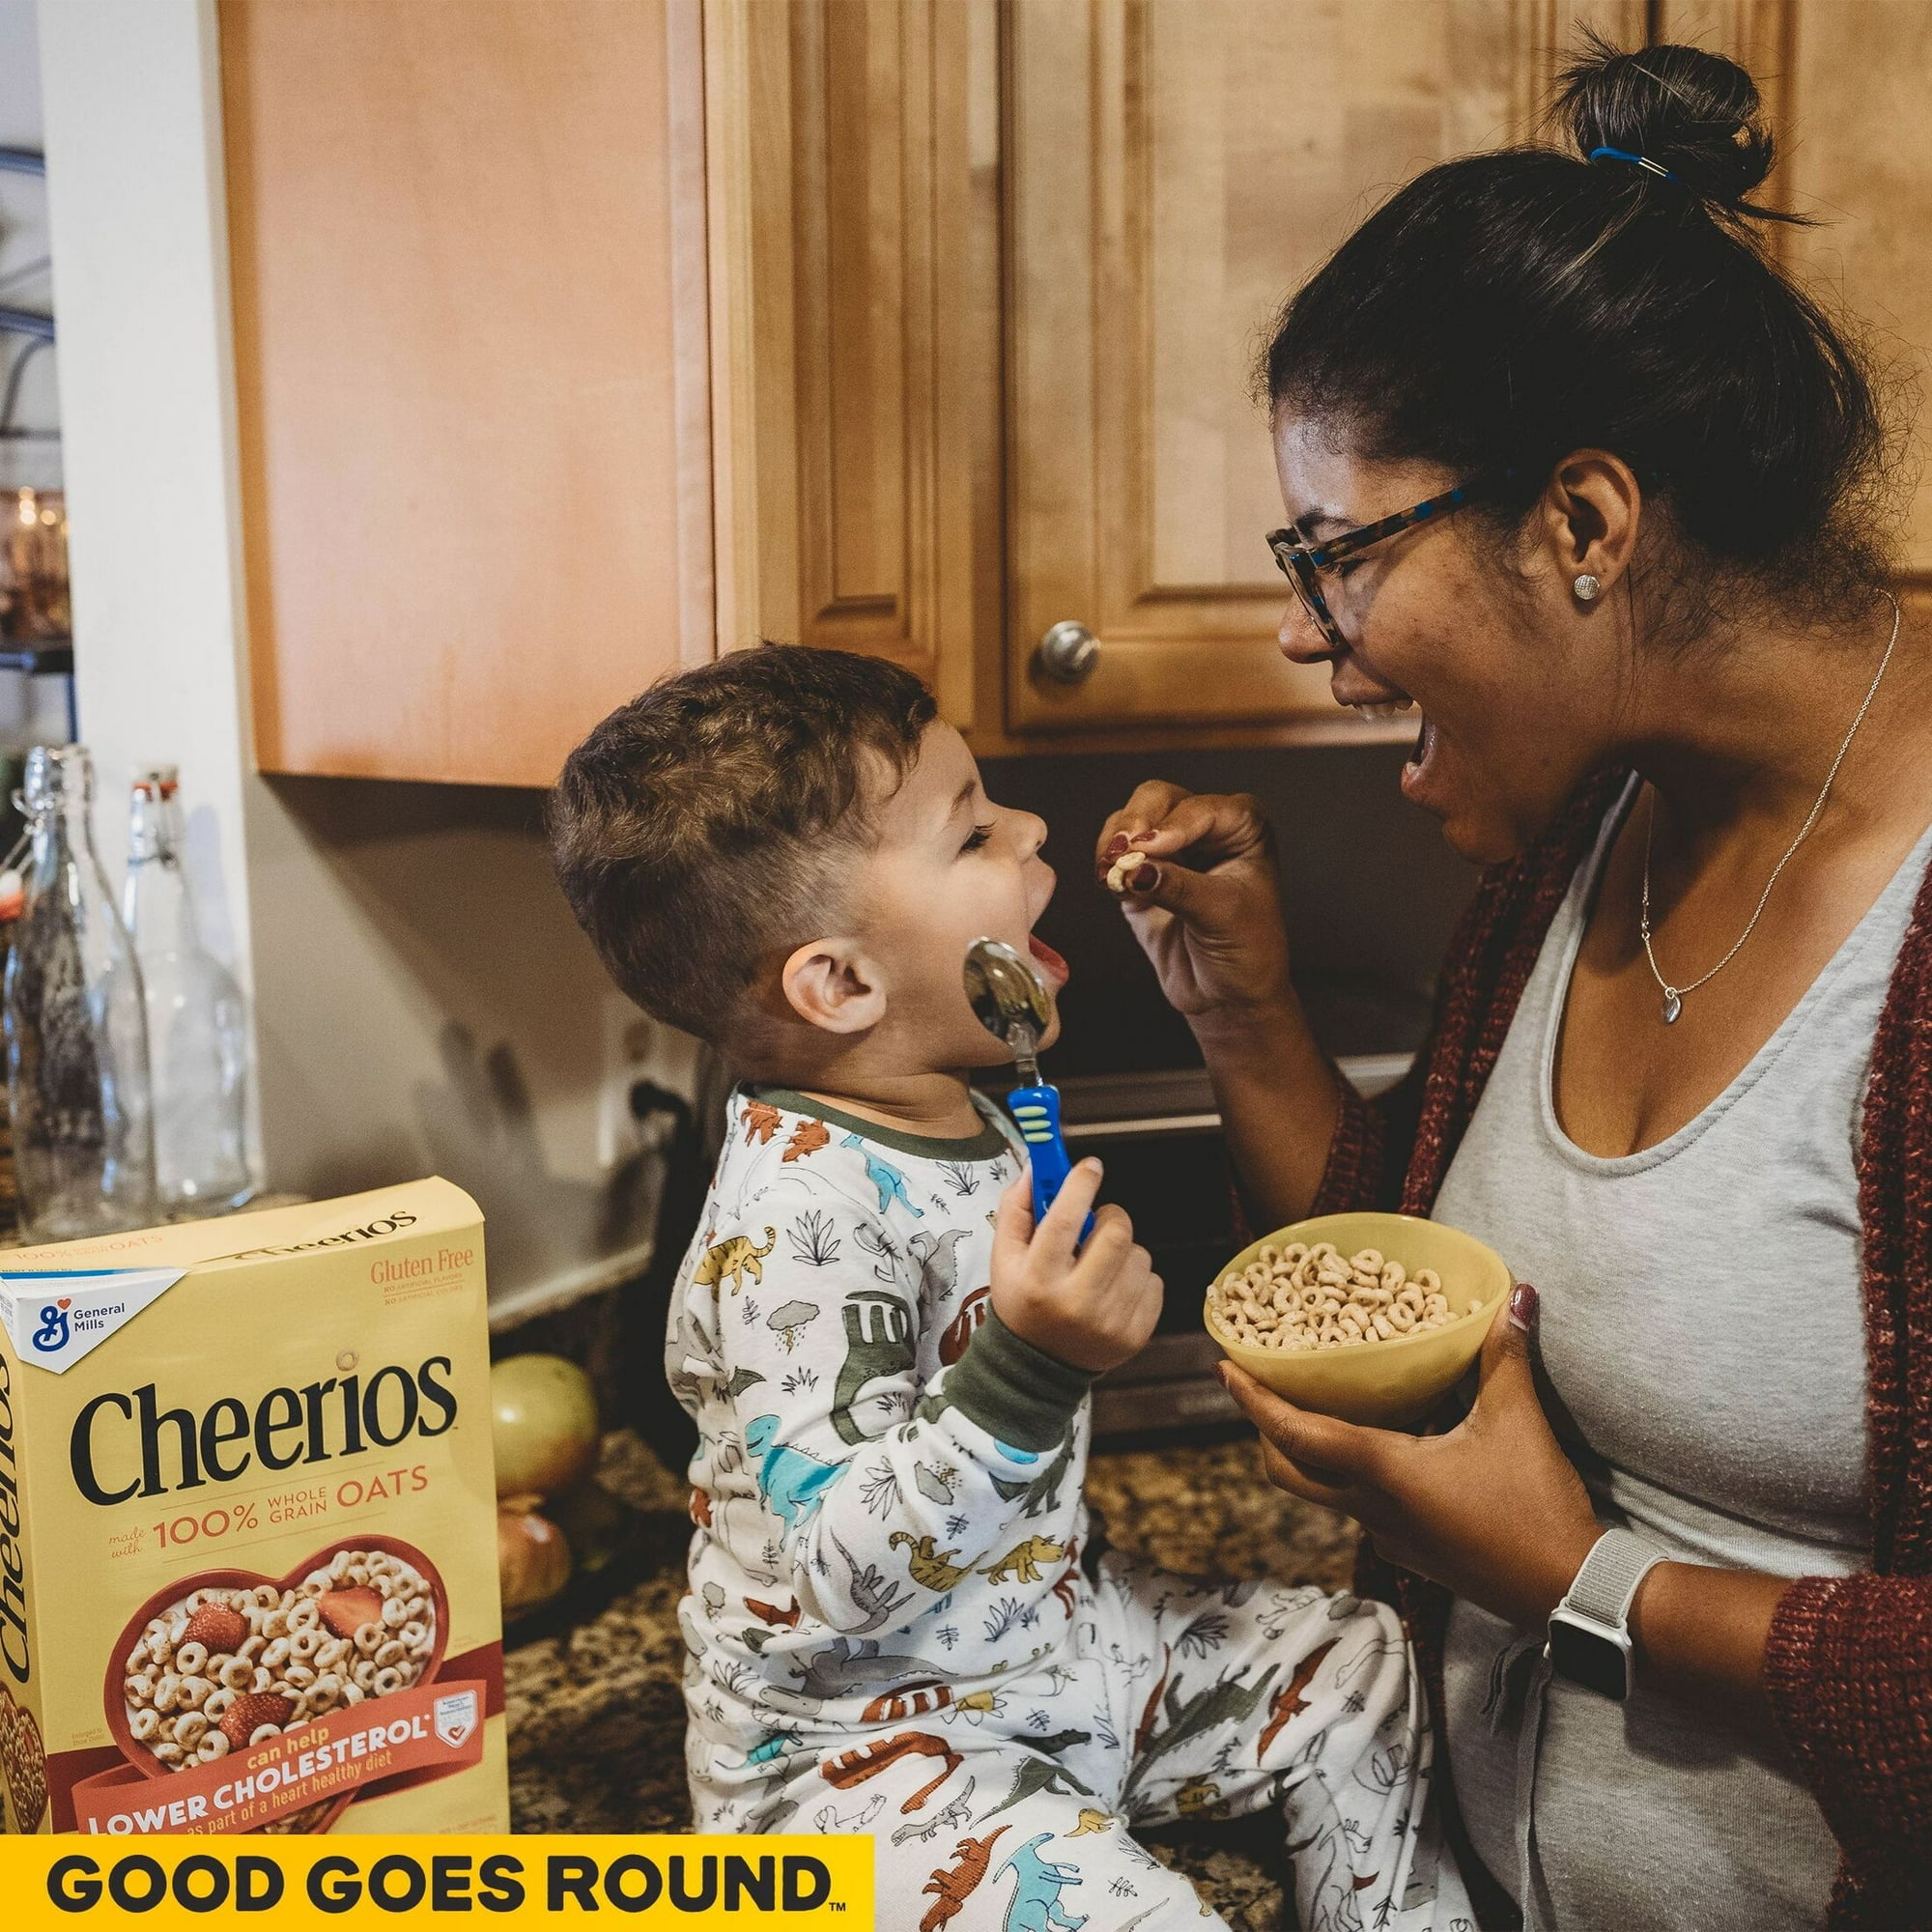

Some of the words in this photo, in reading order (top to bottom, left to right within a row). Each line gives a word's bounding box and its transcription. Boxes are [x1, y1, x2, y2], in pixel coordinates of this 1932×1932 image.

[370, 1257, 433, 1284] Gluten
[438, 1248, 473, 1271] Free
[73, 1302, 125, 1320] General
[74, 1320, 104, 1332] Mills
[70, 1352, 457, 1507] Cheerios
[268, 1486, 327, 1509] WHOLE
[336, 1464, 429, 1507] OATS
[153, 1502, 258, 1549] 100%
[270, 1500, 327, 1523] GRAIN
[108, 1526, 146, 1546] made
[111, 1541, 142, 1559] with
[247, 1746, 281, 1770] can
[286, 1726, 329, 1754] help
[208, 1809, 237, 1834] part
[242, 1800, 255, 1822] of
[259, 1800, 268, 1814] a
[272, 1781, 308, 1809] heart
[312, 1760, 361, 1794] healthy
[365, 1749, 393, 1773] diet
[89, 1795, 209, 1834] LOWER
